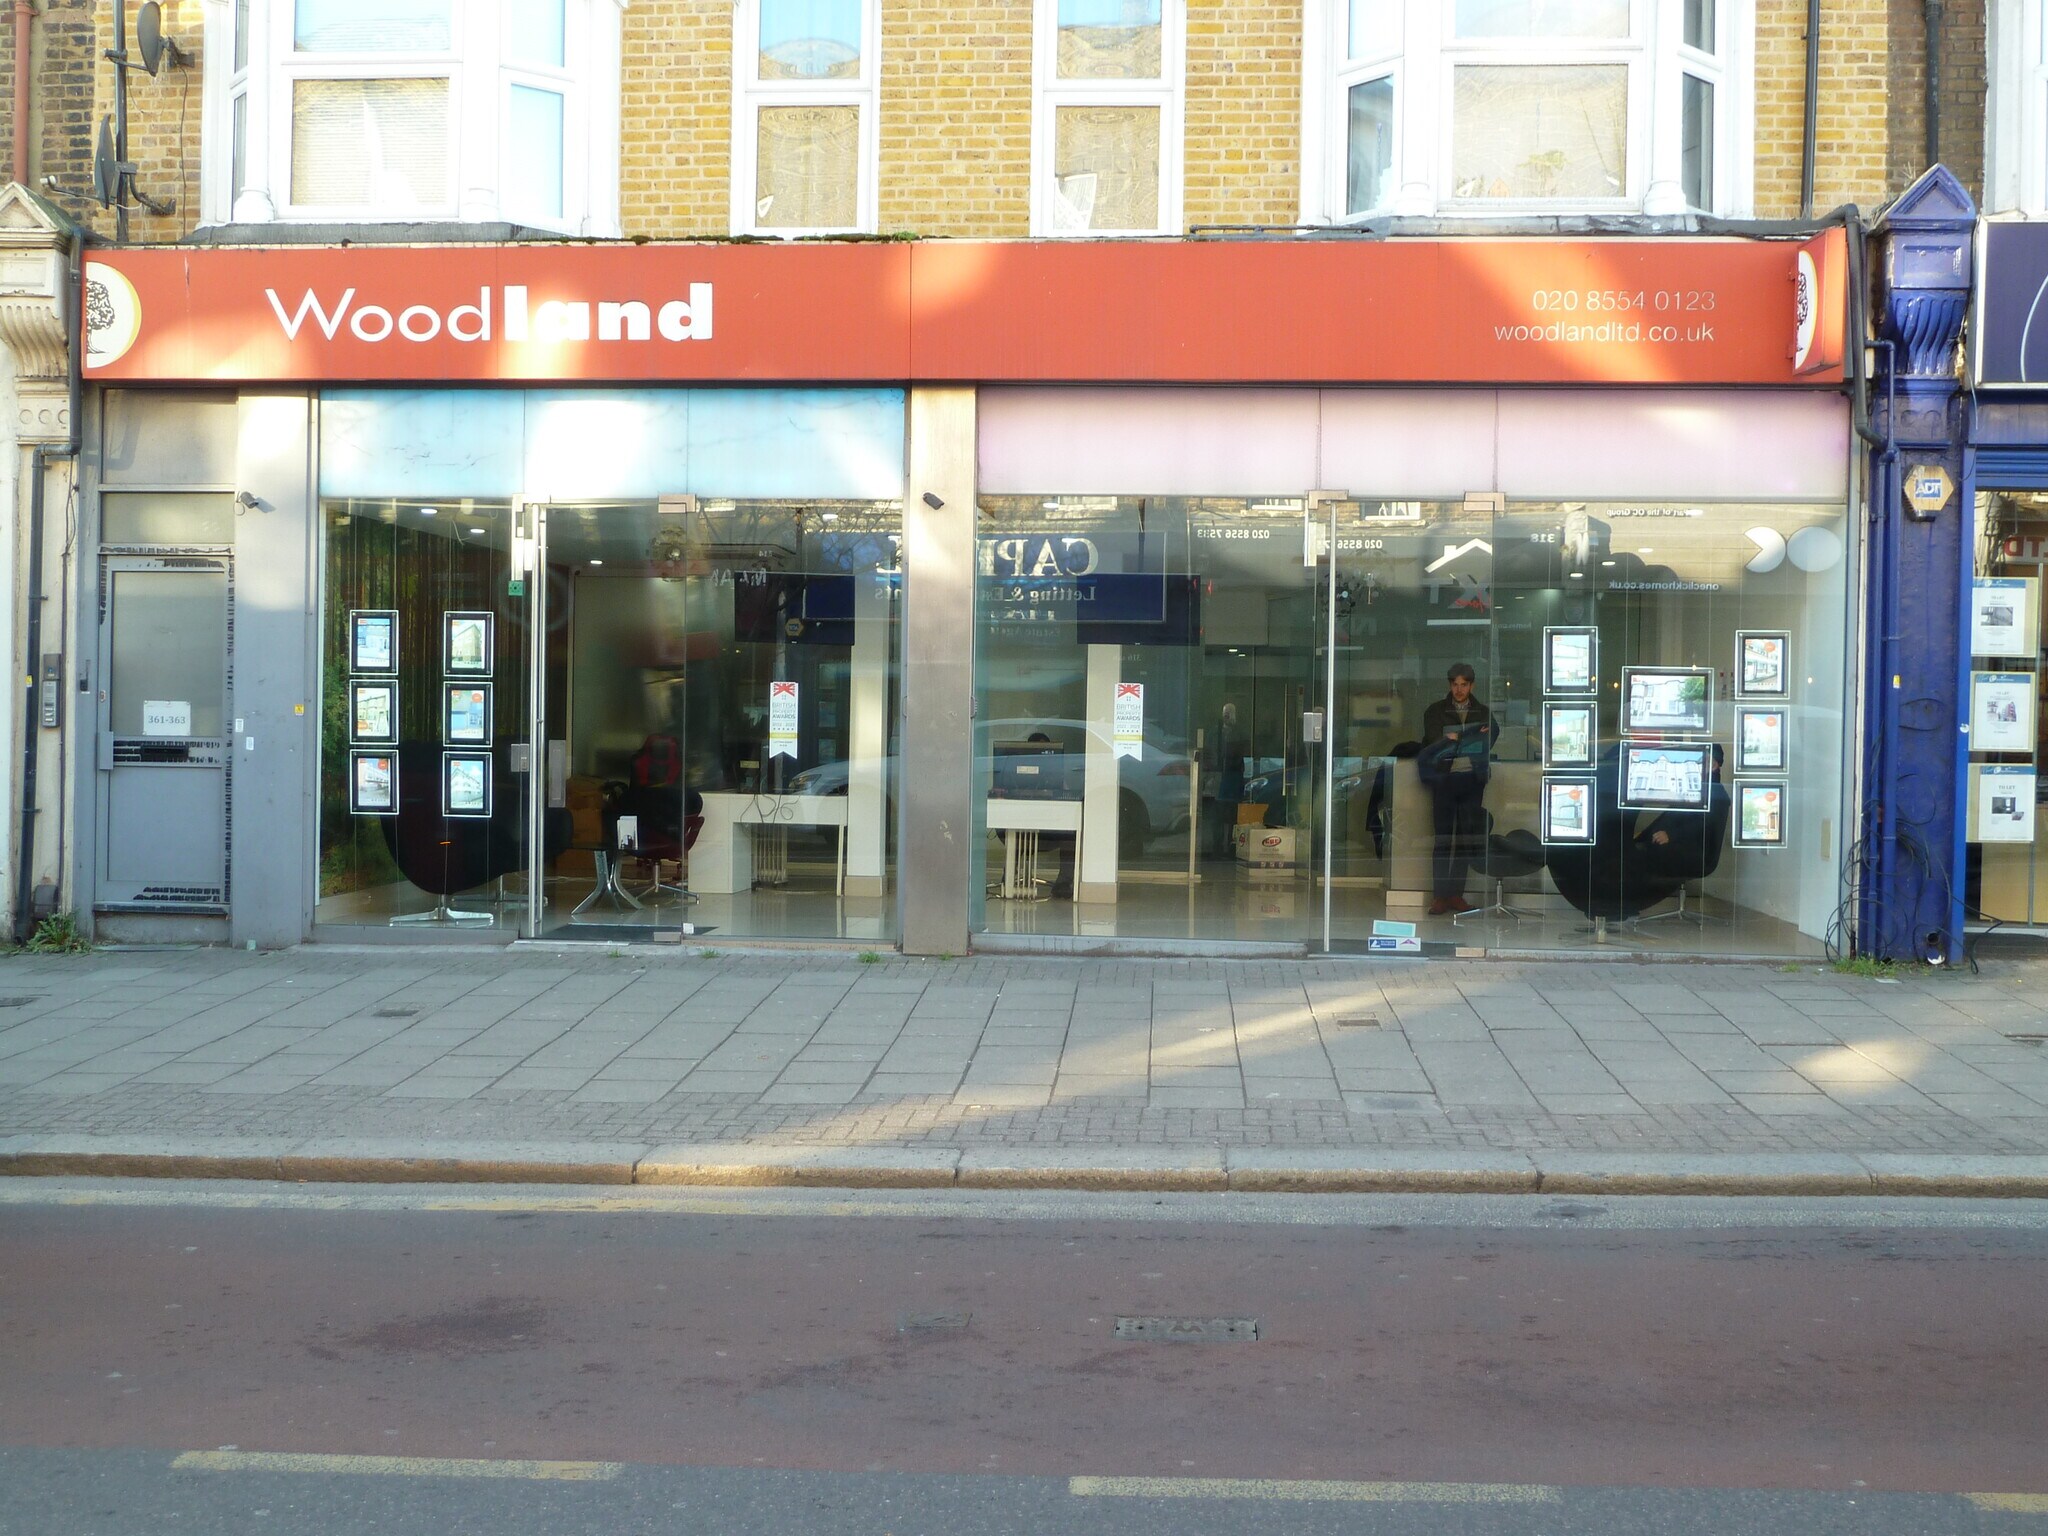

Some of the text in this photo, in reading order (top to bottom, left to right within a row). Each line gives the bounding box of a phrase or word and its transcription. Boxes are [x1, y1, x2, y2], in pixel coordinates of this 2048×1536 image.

[1532, 290, 1716, 311] 020 8554 0123
[265, 282, 714, 343] Woodland
[1494, 322, 1715, 342] woodlandltd.co.uk
[1916, 482, 1941, 495] ADT
[148, 715, 187, 724] 361-363
